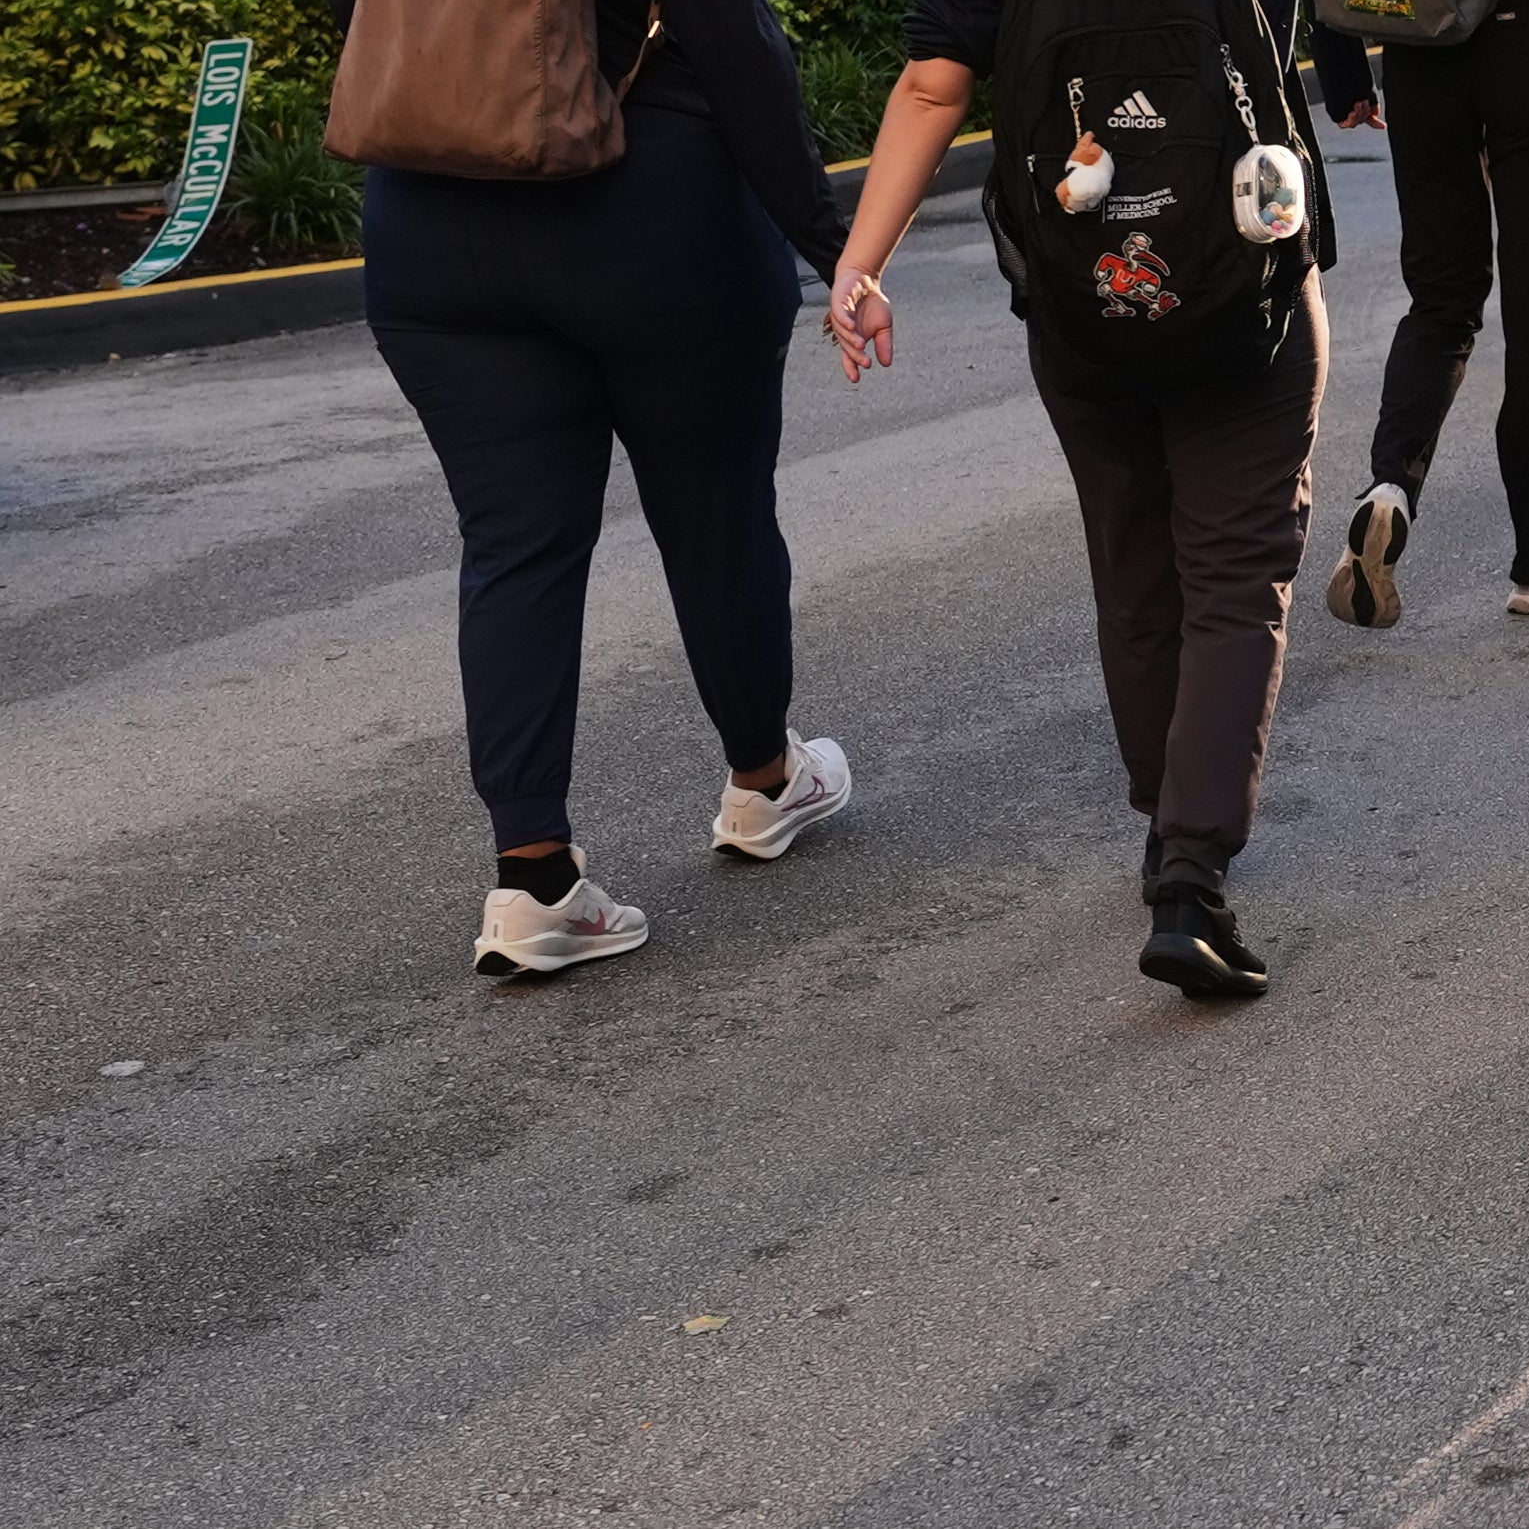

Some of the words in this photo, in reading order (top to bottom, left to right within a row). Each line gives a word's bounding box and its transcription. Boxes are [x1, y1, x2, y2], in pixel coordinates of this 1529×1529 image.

[202, 52, 244, 107] LOIS
[1107, 115, 1167, 129] adidas
[157, 123, 231, 248] McCULLAR
[1107, 203, 1142, 212] MILLER
[1142, 195, 1178, 210] SCHOOL
